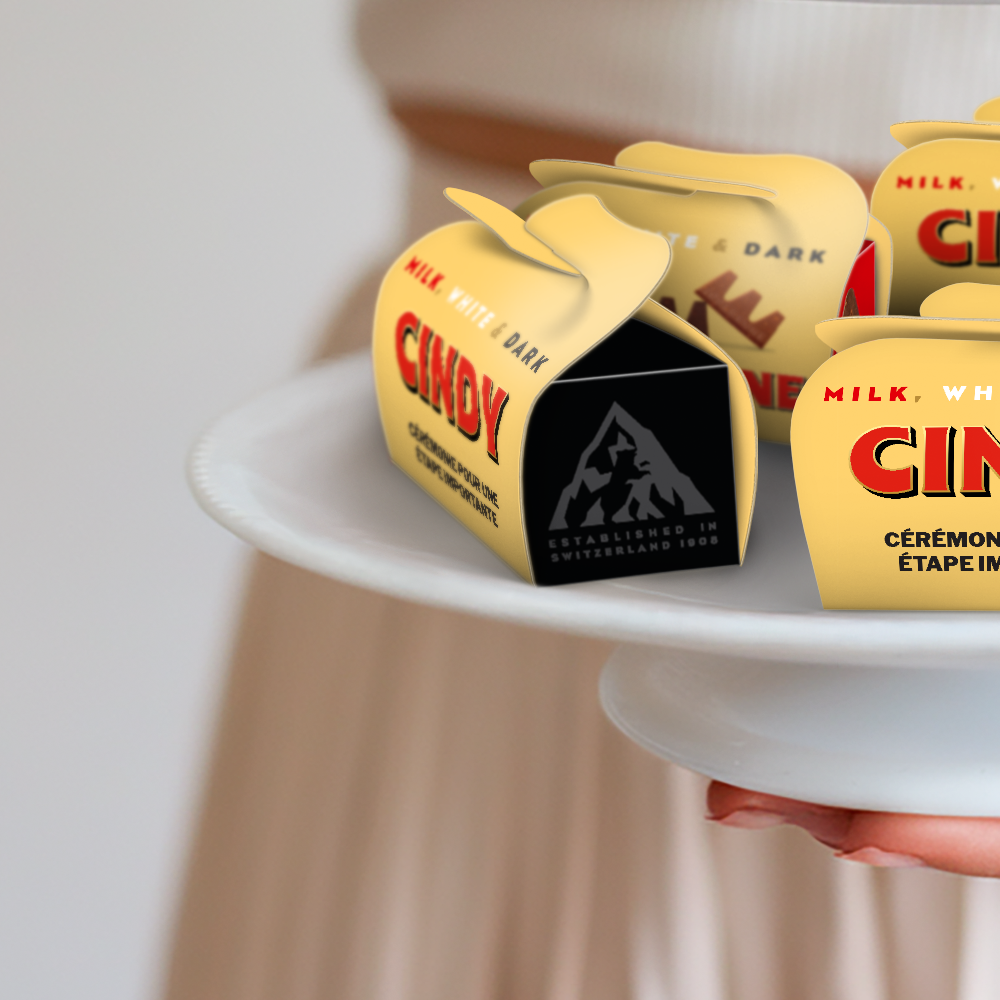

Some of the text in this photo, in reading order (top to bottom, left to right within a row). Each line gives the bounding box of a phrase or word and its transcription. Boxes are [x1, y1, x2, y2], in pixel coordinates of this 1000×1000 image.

[744, 242, 826, 264] DARK
[447, 285, 495, 330] WHITE
[503, 332, 549, 373] DARK
[395, 311, 509, 465] CINDY
[823, 386, 922, 403] MILK,
[549, 521, 717, 548] ESTABLISHED IN
[551, 535, 718, 562] SWITZERLAND 1908
[899, 551, 974, 572] ÉTAPE
